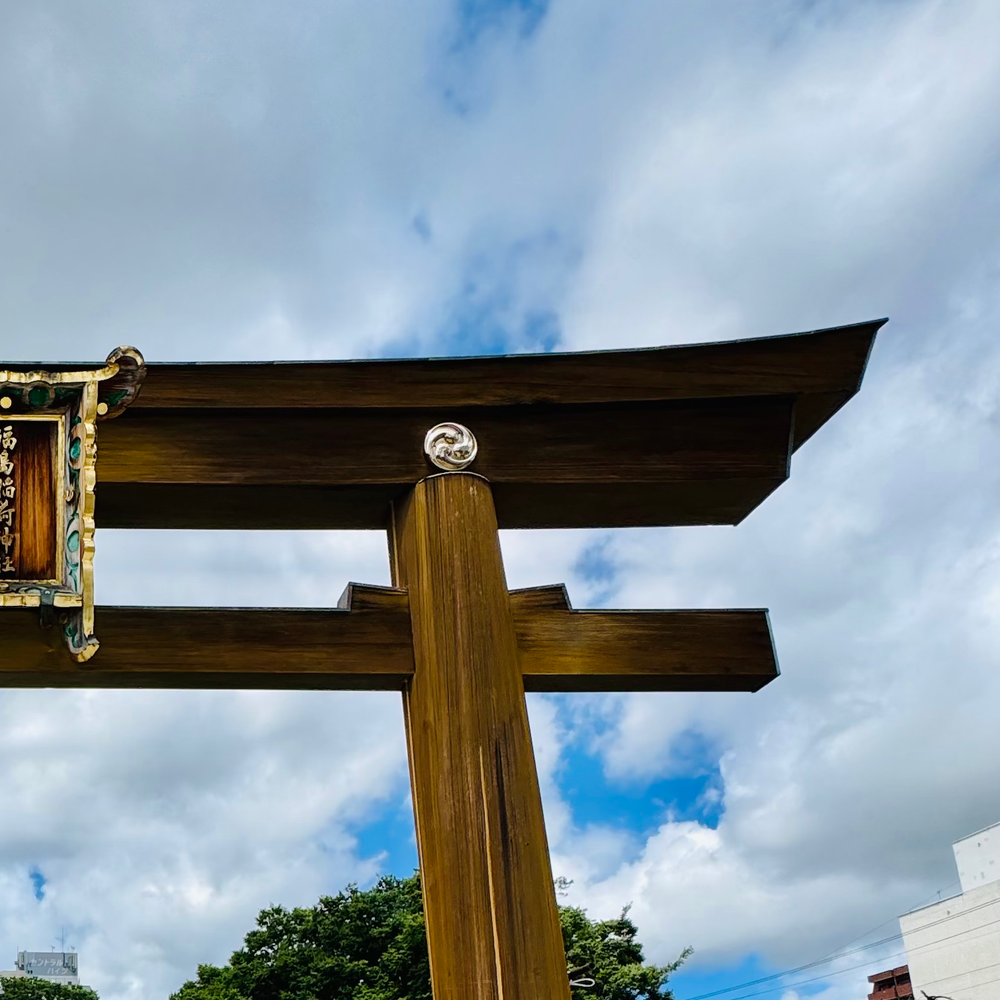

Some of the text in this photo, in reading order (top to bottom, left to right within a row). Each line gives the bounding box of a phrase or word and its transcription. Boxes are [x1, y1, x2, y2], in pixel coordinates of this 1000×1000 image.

[31, 958, 64, 967] セントラル
